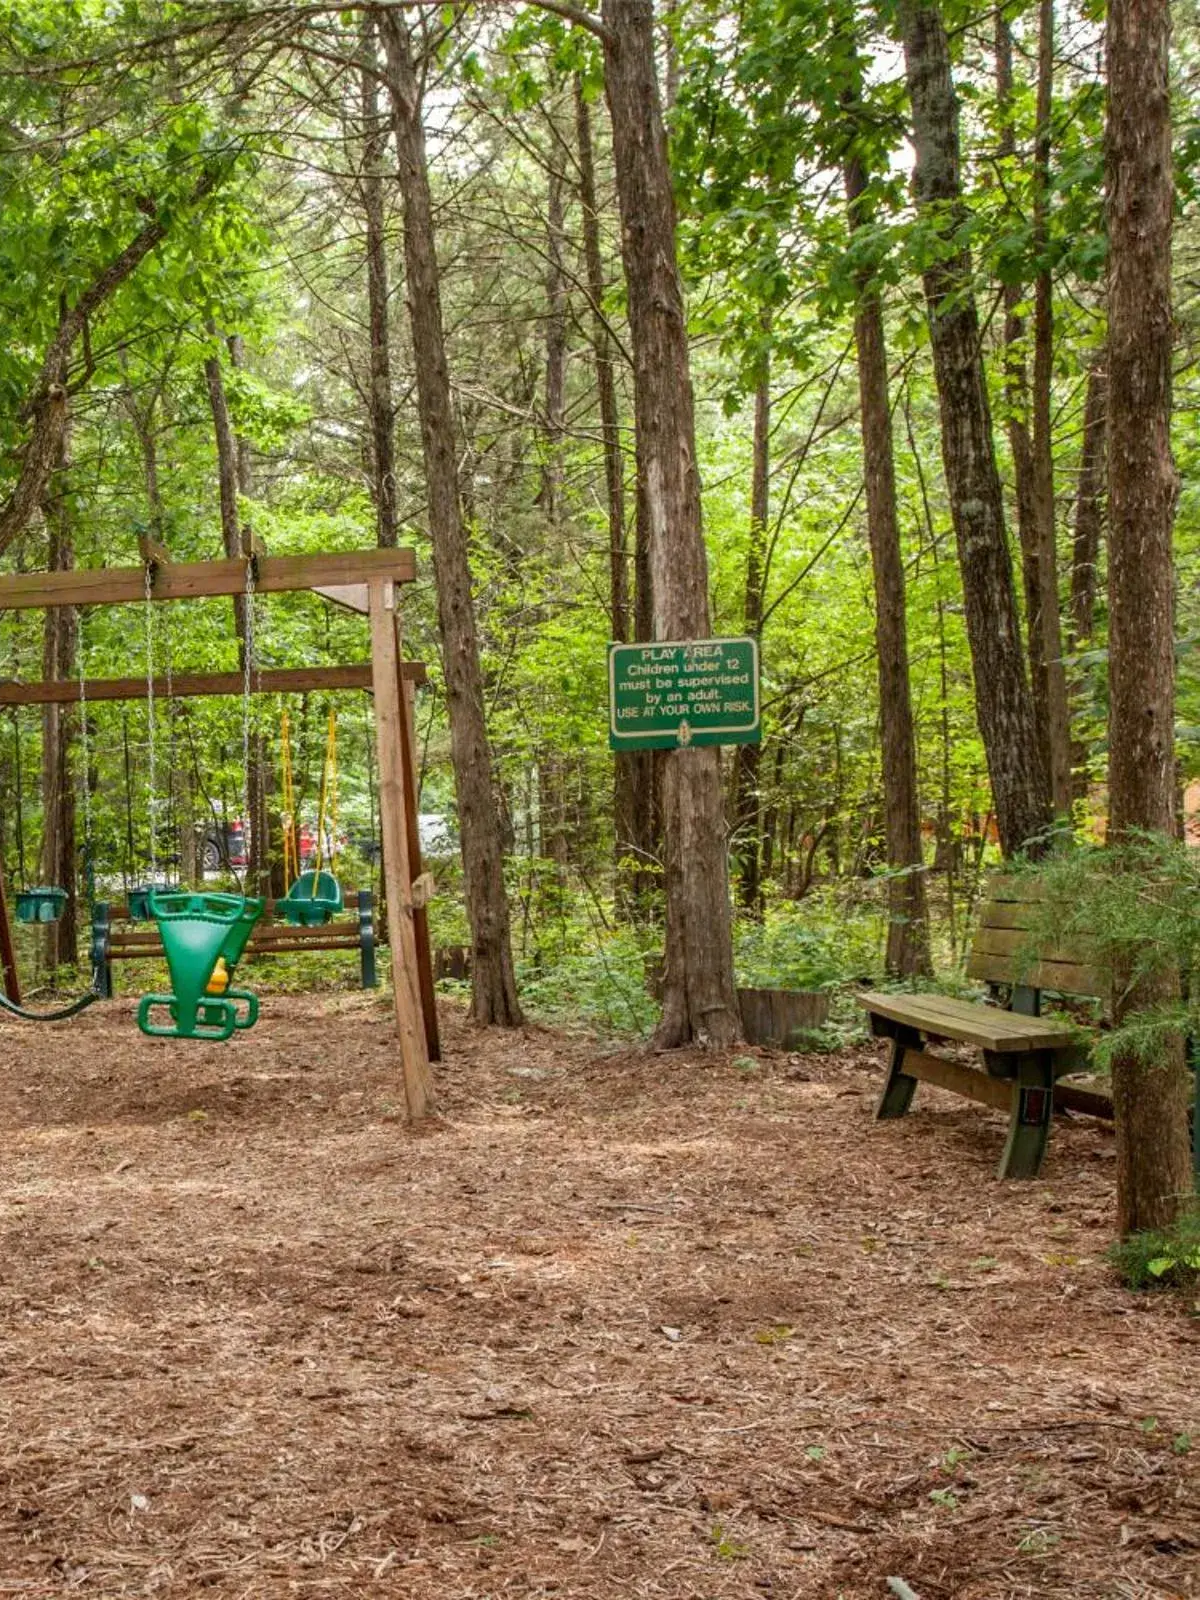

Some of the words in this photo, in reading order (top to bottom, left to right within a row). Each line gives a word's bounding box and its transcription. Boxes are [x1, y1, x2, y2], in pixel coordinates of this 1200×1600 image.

[641, 648, 677, 661] PLAY
[627, 663, 679, 677] Children
[684, 660, 720, 673] under
[726, 658, 740, 670] 12
[619, 679, 651, 691] must
[655, 677, 673, 689] be
[678, 673, 749, 689] supervised
[646, 692, 661, 704] by
[666, 693, 683, 702] an
[687, 689, 722, 701] adult.
[617, 707, 639, 719] USE
[643, 706, 656, 717] AT
[659, 703, 690, 717] YOUR
[693, 702, 721, 714] OWN
[724, 700, 753, 713] RISK.
